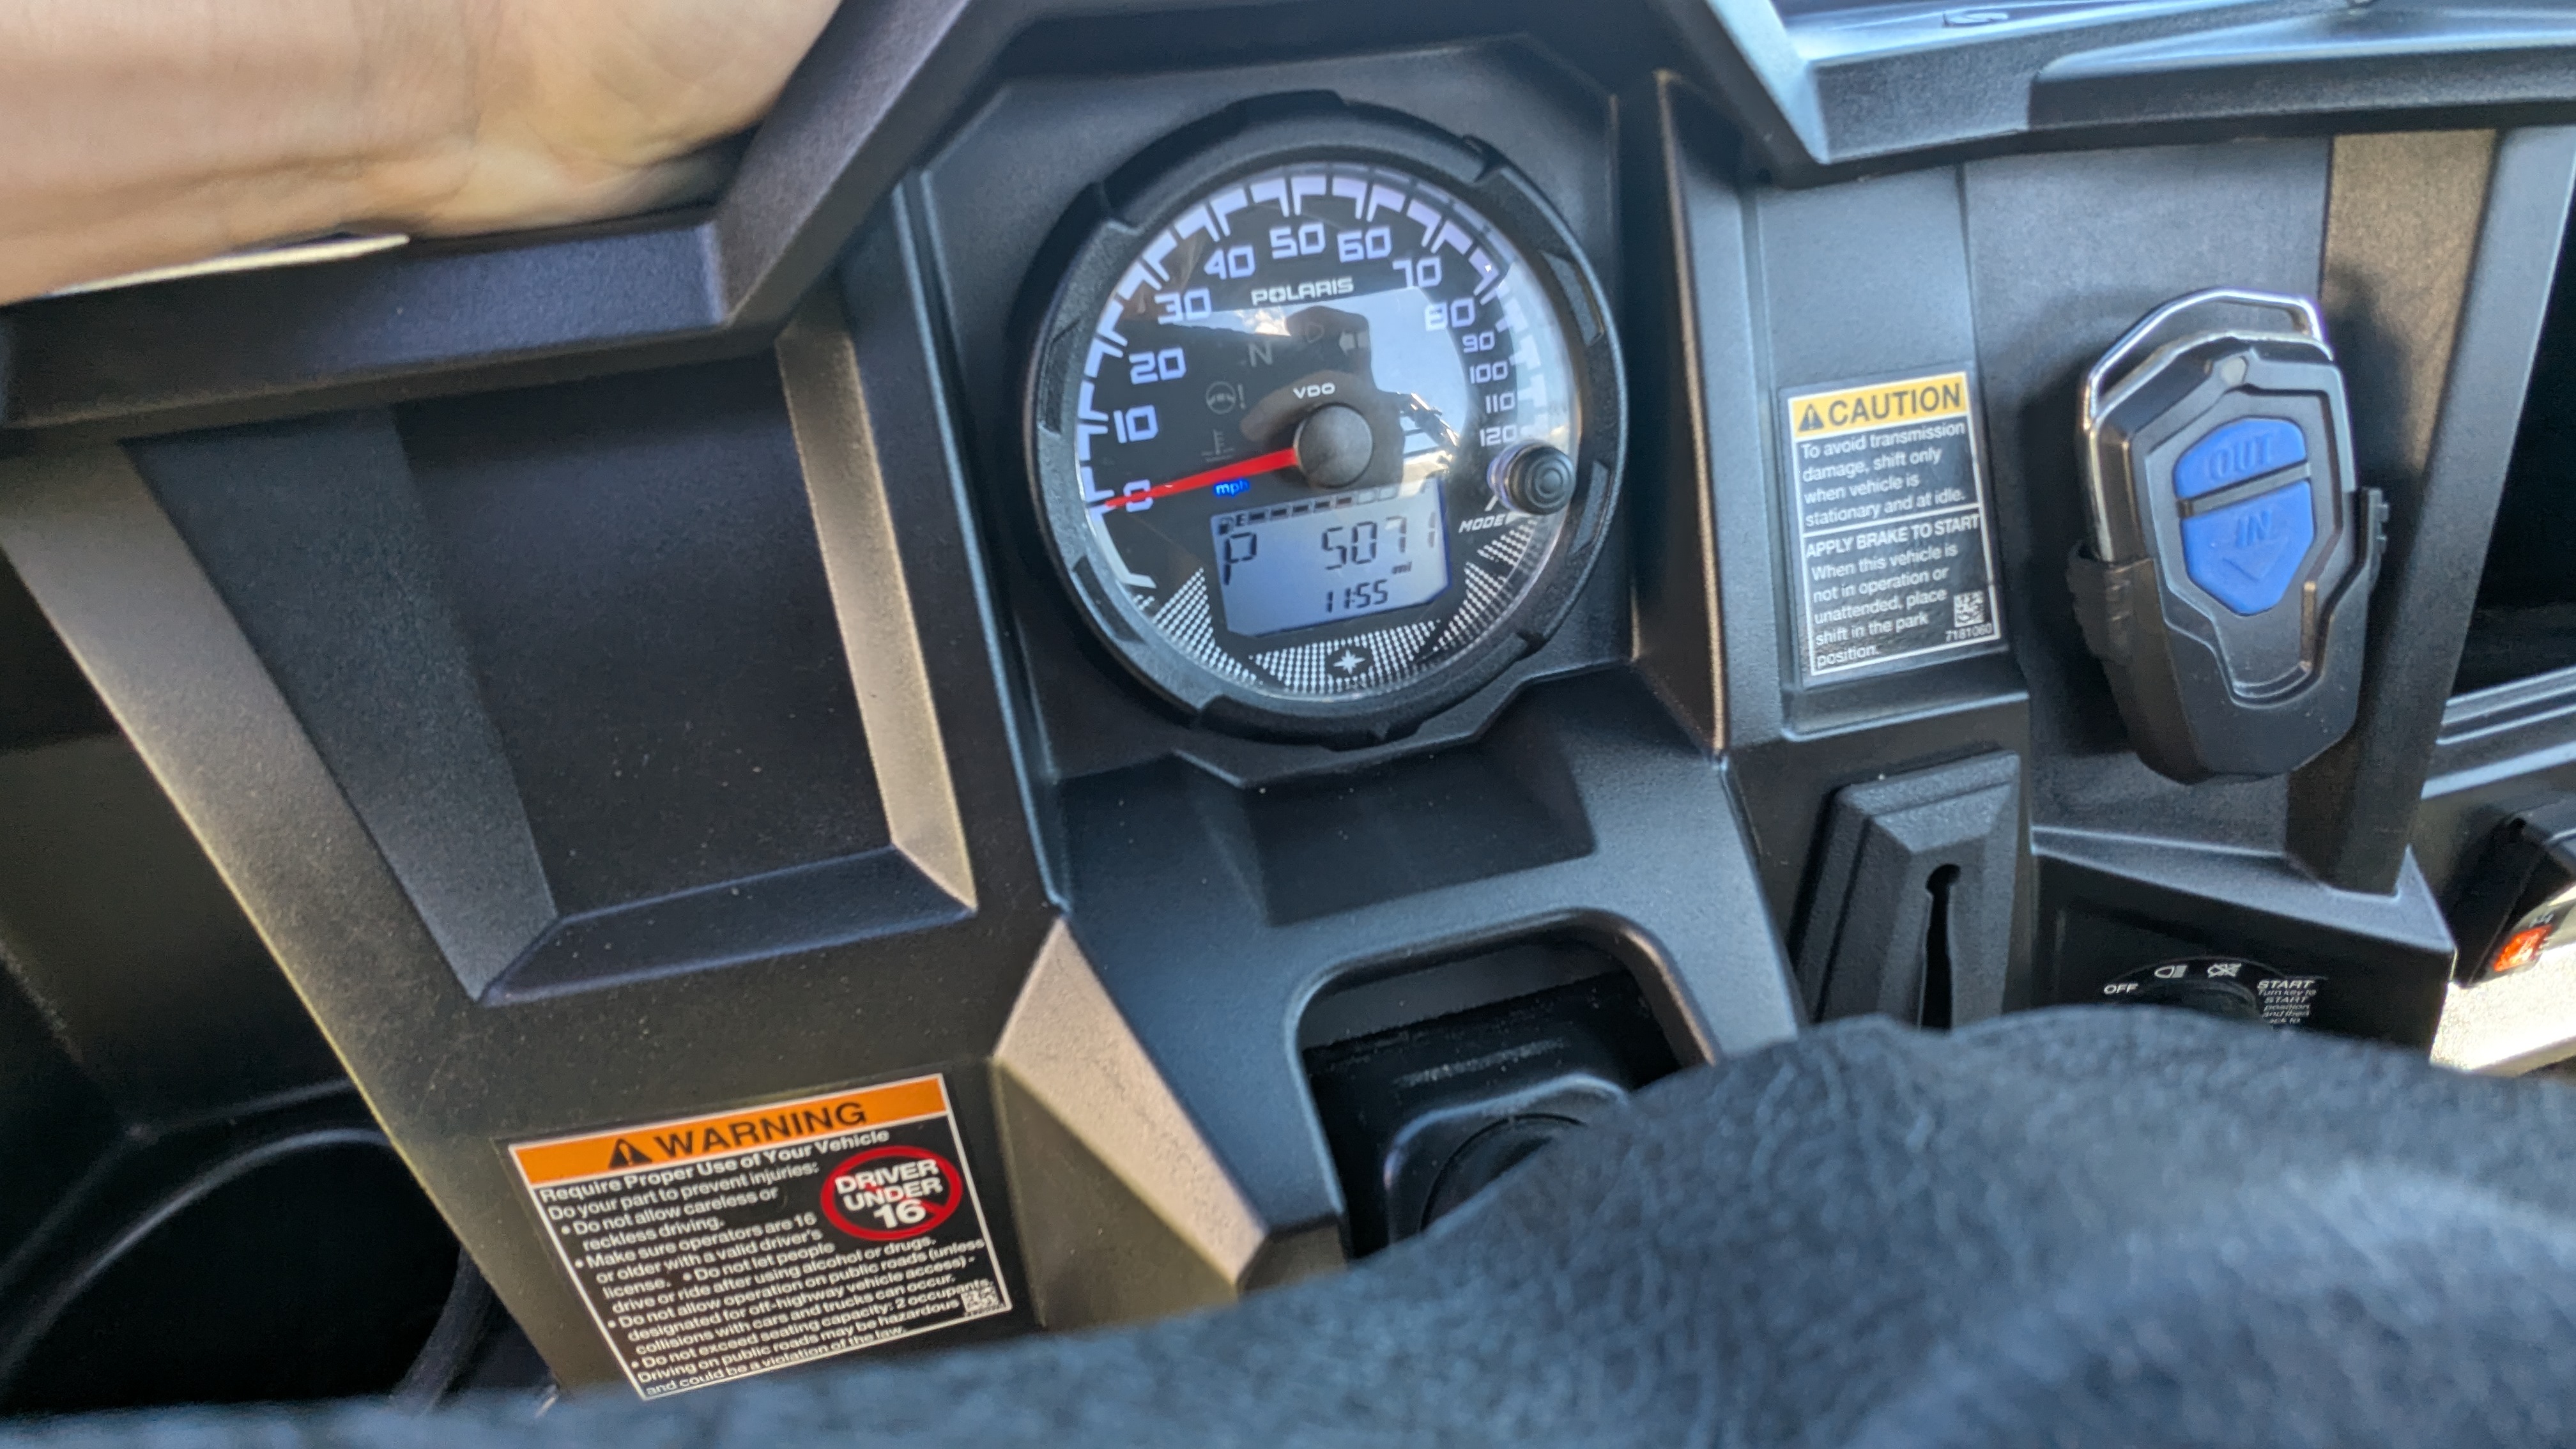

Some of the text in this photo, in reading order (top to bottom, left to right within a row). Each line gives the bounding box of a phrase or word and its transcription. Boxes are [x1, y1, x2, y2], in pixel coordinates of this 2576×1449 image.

[1269, 222, 1326, 259] 50
[1337, 226, 1392, 263] 60
[1204, 244, 1256, 280] 40
[1392, 256, 1442, 288] 70
[1154, 288, 1213, 325] 30
[1251, 277, 1354, 306] POLARIS
[1424, 298, 1476, 332] 80
[1462, 331, 1496, 353] 90
[1129, 346, 1186, 385] 20
[1469, 360, 1509, 384] 100
[1292, 382, 1335, 399] VDO
[1485, 392, 1516, 414] 110
[1828, 382, 1960, 426] CAUTION
[1113, 405, 1159, 443] 10
[1480, 424, 1517, 447] 120
[1800, 422, 1965, 459] To avoid transmission
[1802, 446, 1942, 482] damage, shift only
[2210, 433, 2273, 481] OUT
[1123, 479, 1154, 512] 0
[1214, 477, 1251, 498] mph
[1804, 473, 1919, 504] when vehicle is
[1458, 512, 1506, 534] MODE
[1805, 487, 1965, 526] stationary and at idle.
[1805, 513, 1979, 558] APPLY BRAKE TO START
[2237, 507, 2273, 549] IN
[1223, 532, 1258, 586] P
[1811, 542, 1958, 581] When this vehicle is
[1326, 579, 1389, 613] 11:55
[1813, 567, 1949, 602] not in operation or
[1813, 588, 1947, 627] unattended, place
[1814, 611, 1928, 646] shift in the park
[1816, 645, 1879, 669] position.
[2103, 983, 2140, 995] OFF
[2257, 979, 2315, 990] START
[653, 1101, 866, 1157] WARNING
[538, 1130, 889, 1203] Require Proper Use of Your Vehicle
[834, 1158, 939, 1194] DRIVER
[547, 1206, 576, 1220] Do
[576, 1199, 617, 1218] your
[619, 1190, 658, 1211] part
[657, 1188, 679, 1201] to
[679, 1174, 749, 1200] prevent
[572, 1186, 778, 1235] Do not allow careless or
[843, 1177, 942, 1211] UNDER
[873, 1198, 926, 1228] 16
[582, 1229, 657, 1251] reckless
[585, 1211, 816, 1268] Make sure operators are 16
[595, 1229, 822, 1284] or older with a valid driver's
[611, 1297, 656, 1314] drive
[656, 1292, 675, 1304] or
[677, 1284, 711, 1300] ride
[712, 1276, 751, 1292] after
[753, 1265, 802, 1284] using
[802, 1249, 862, 1273] alcohol
[863, 1246, 881, 1259] or
[693, 1268, 720, 1280] Do
[721, 1259, 751, 1275] not
[751, 1254, 775, 1268] let
[776, 1243, 834, 1266] people
[617, 1314, 645, 1328] Do
[645, 1307, 676, 1322] not
[677, 1298, 721, 1316] allow
[723, 1280, 803, 1306] operation
[804, 1275, 827, 1287] on
[827, 1263, 879, 1285] public
[880, 1252, 927, 1270] roads
[627, 1312, 721, 1341] designated
[722, 1308, 746, 1321] for
[748, 1285, 844, 1315] off-highway
[845, 1271, 903, 1292] vehicle
[635, 1330, 714, 1354] collisions
[714, 1321, 751, 1337] with
[751, 1313, 788, 1329] cars
[790, 1303, 822, 1321] and
[822, 1293, 874, 1312] trucks
[875, 1285, 905, 1300] can
[641, 1355, 668, 1368] Do
[668, 1347, 697, 1362] not
[698, 1333, 759, 1356] exceed
[760, 1319, 821, 1342] seating
[894, 1296, 906, 1309] 2
[636, 1363, 697, 1383] Driving
[697, 1358, 720, 1369] on
[720, 1346, 771, 1367] public
[772, 1334, 819, 1352] roads
[820, 1325, 854, 1340] may
[854, 1319, 877, 1331] be
[877, 1299, 960, 1326] hazardous
[645, 1379, 678, 1395] and
[678, 1368, 725, 1387] could
[724, 1365, 747, 1376] be
[749, 1361, 761, 1370] a
[830, 1338, 847, 1351] of
[847, 1333, 874, 1347] the
